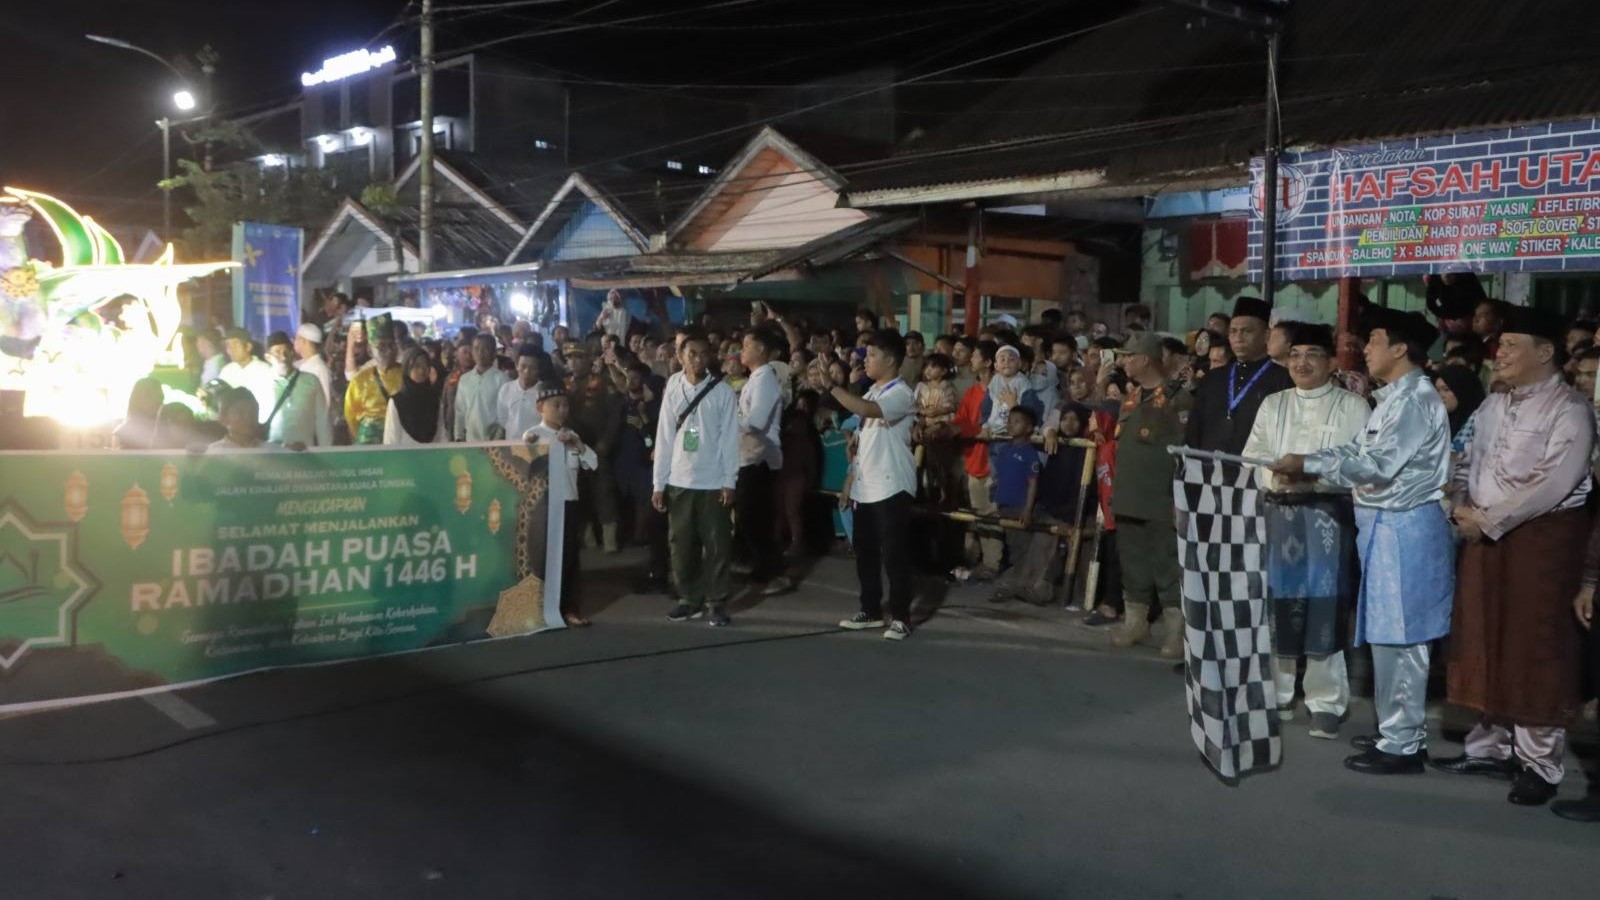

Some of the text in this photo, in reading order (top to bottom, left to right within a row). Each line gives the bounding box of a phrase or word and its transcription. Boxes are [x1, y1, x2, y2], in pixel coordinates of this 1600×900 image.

[1330, 160, 1502, 204] HAFSAH
[1332, 212, 1382, 227] UNDANGAN
[1389, 210, 1416, 223] NOTA
[1424, 208, 1446, 221] KOP
[1448, 205, 1481, 219] SURAT
[1490, 202, 1529, 216] YAASIN
[1366, 228, 1424, 242] PENJILIDAN
[1431, 225, 1459, 238] HARD
[1462, 222, 1497, 236] COVER
[1505, 221, 1535, 234] SOFT
[1538, 218, 1578, 233] COVER
[1306, 250, 1345, 263] SPANDUK
[1352, 247, 1392, 260] BALEHO
[1399, 247, 1407, 258] X
[1415, 244, 1456, 258] BANNER
[1465, 242, 1486, 255] ONE
[1488, 240, 1512, 254] WAY
[1521, 238, 1561, 253] STIKER
[216, 486, 247, 496] JALAN
[349, 480, 378, 490] KUALA
[275, 497, 367, 516] MENGUCAPKAN
[216, 515, 420, 539] SELAMAT MENJALANKAN
[172, 530, 452, 577] IBADAH PUASA
[131, 554, 477, 612] RAMADHAN 1446 H
